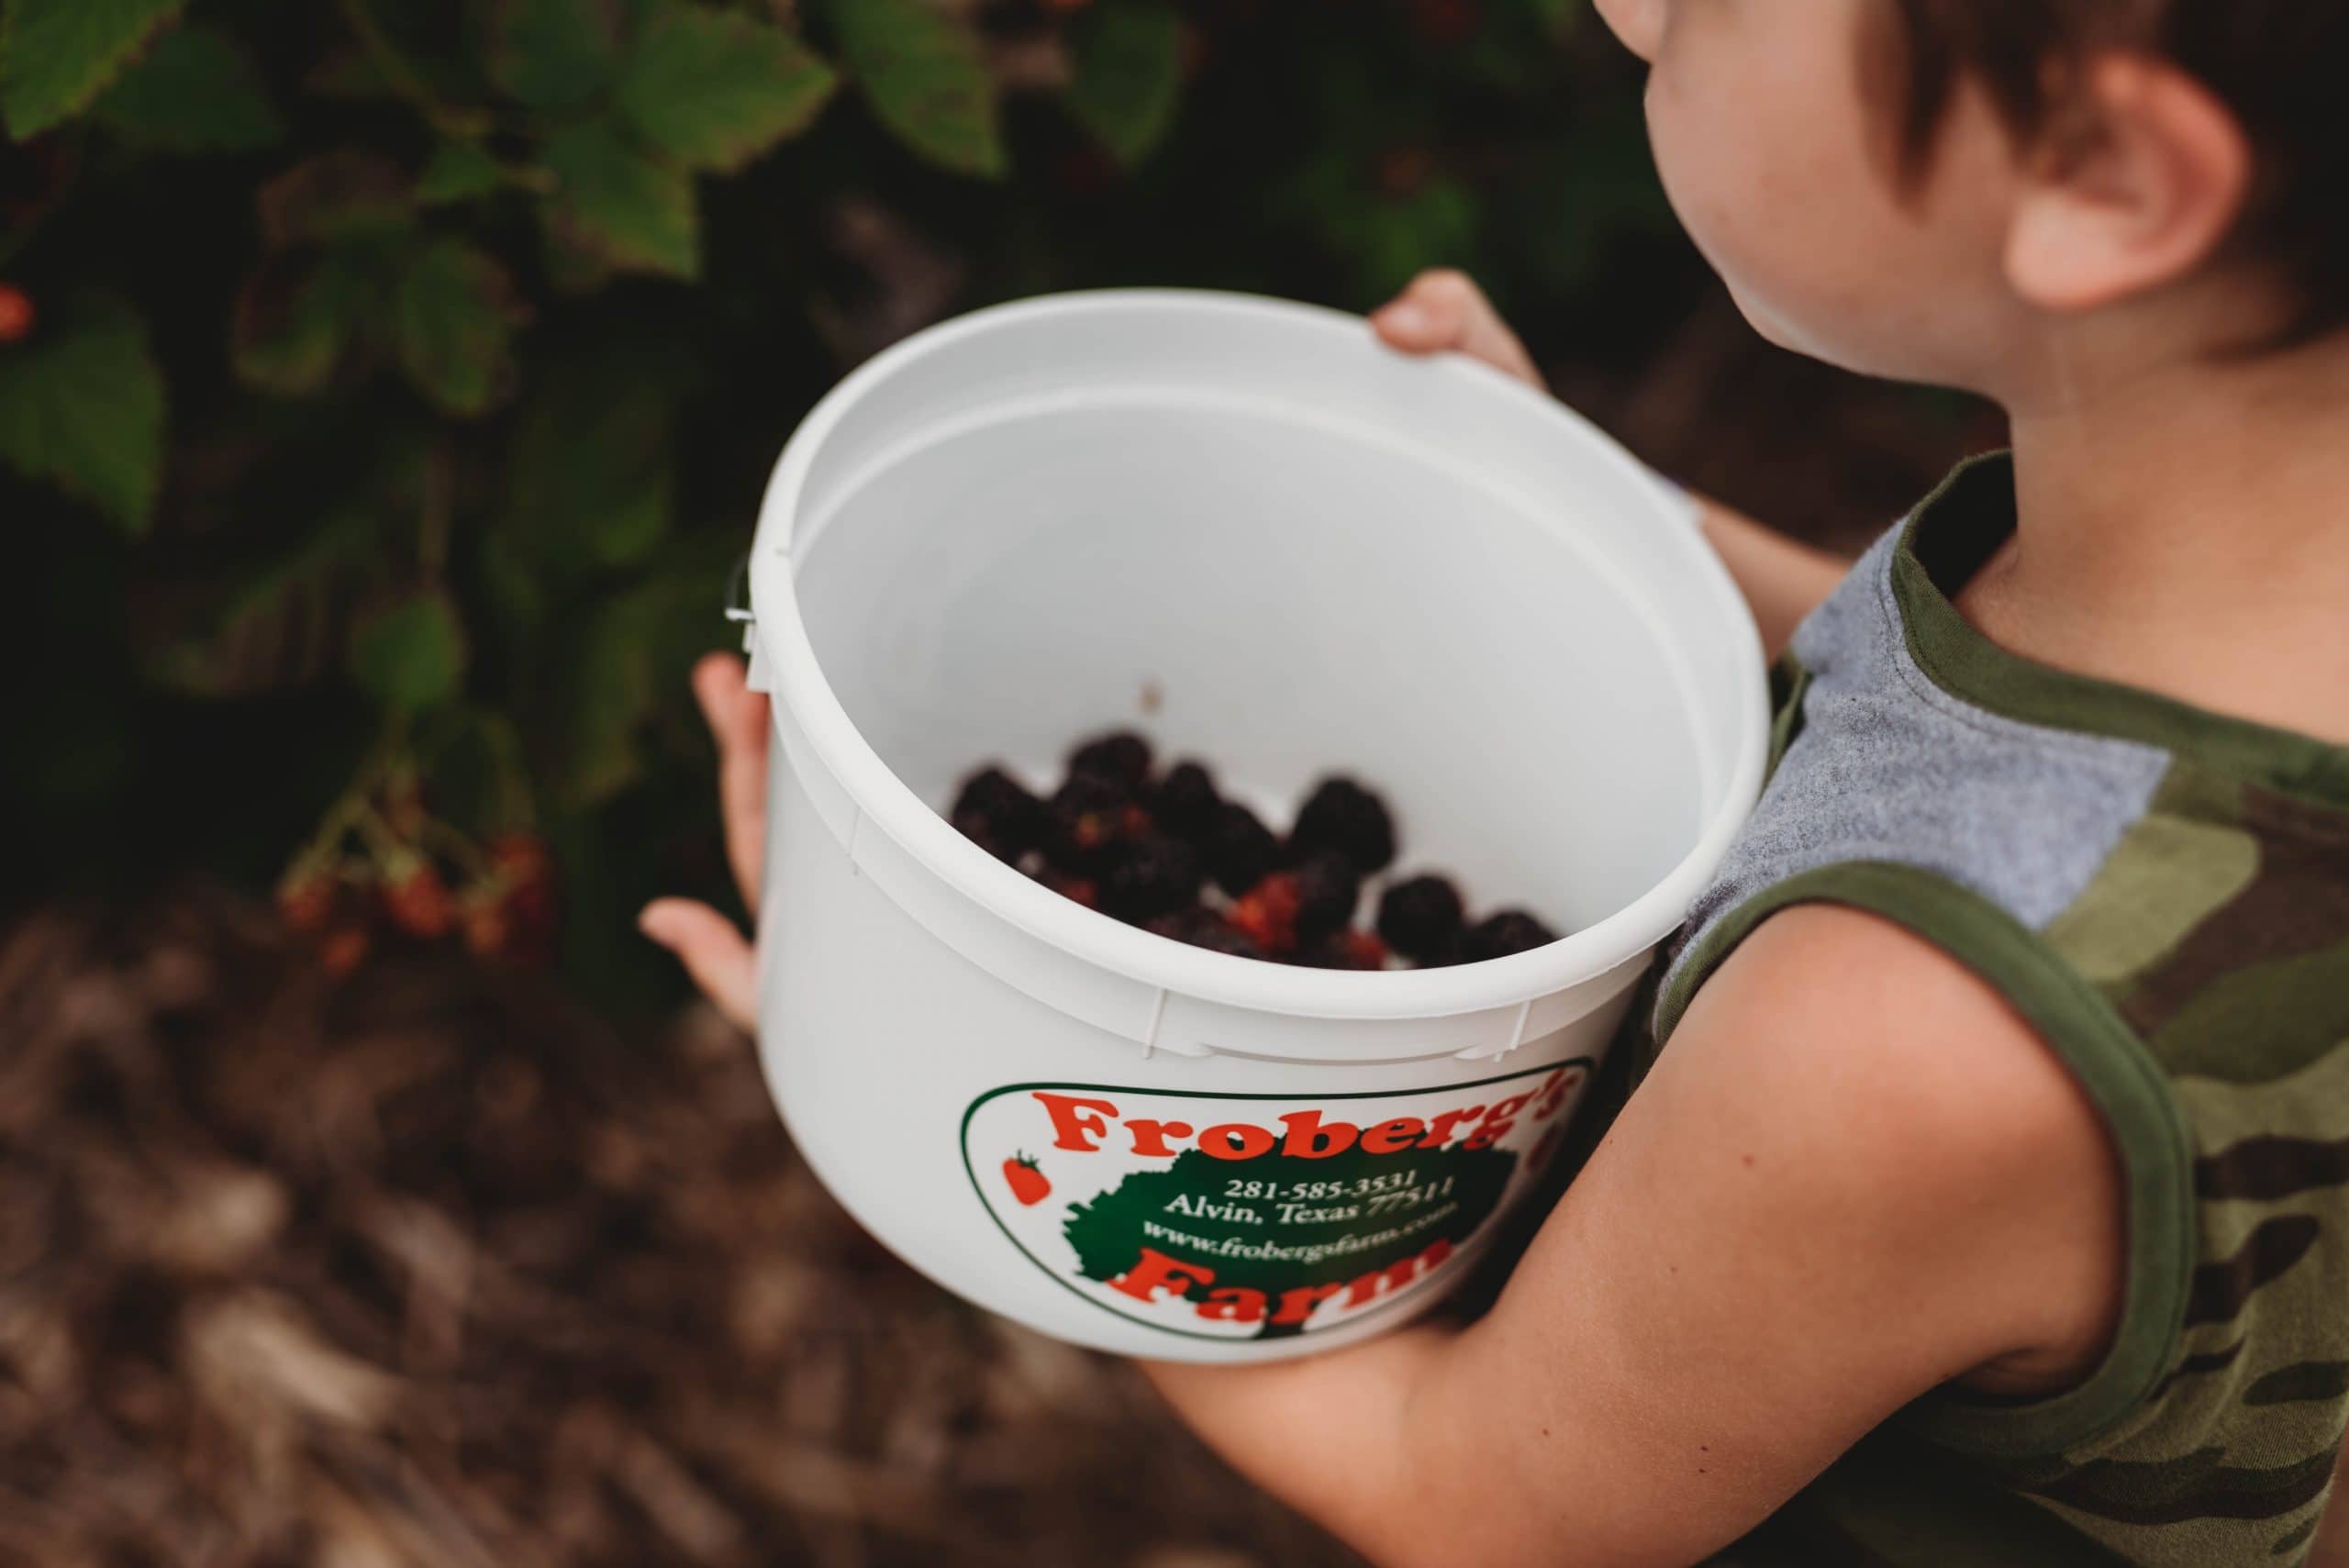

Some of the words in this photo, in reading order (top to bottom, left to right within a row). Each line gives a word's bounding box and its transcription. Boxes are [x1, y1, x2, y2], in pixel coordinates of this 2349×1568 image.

[1031, 1068, 1579, 1160] Froberg's
[1224, 1169, 1418, 1200] 281-585-3531
[1275, 1203, 1360, 1224] Texas
[1366, 1175, 1454, 1218] 77511
[1143, 1201, 1459, 1264] www.frobergsfarm.com
[1106, 1238, 1452, 1323] Farm
